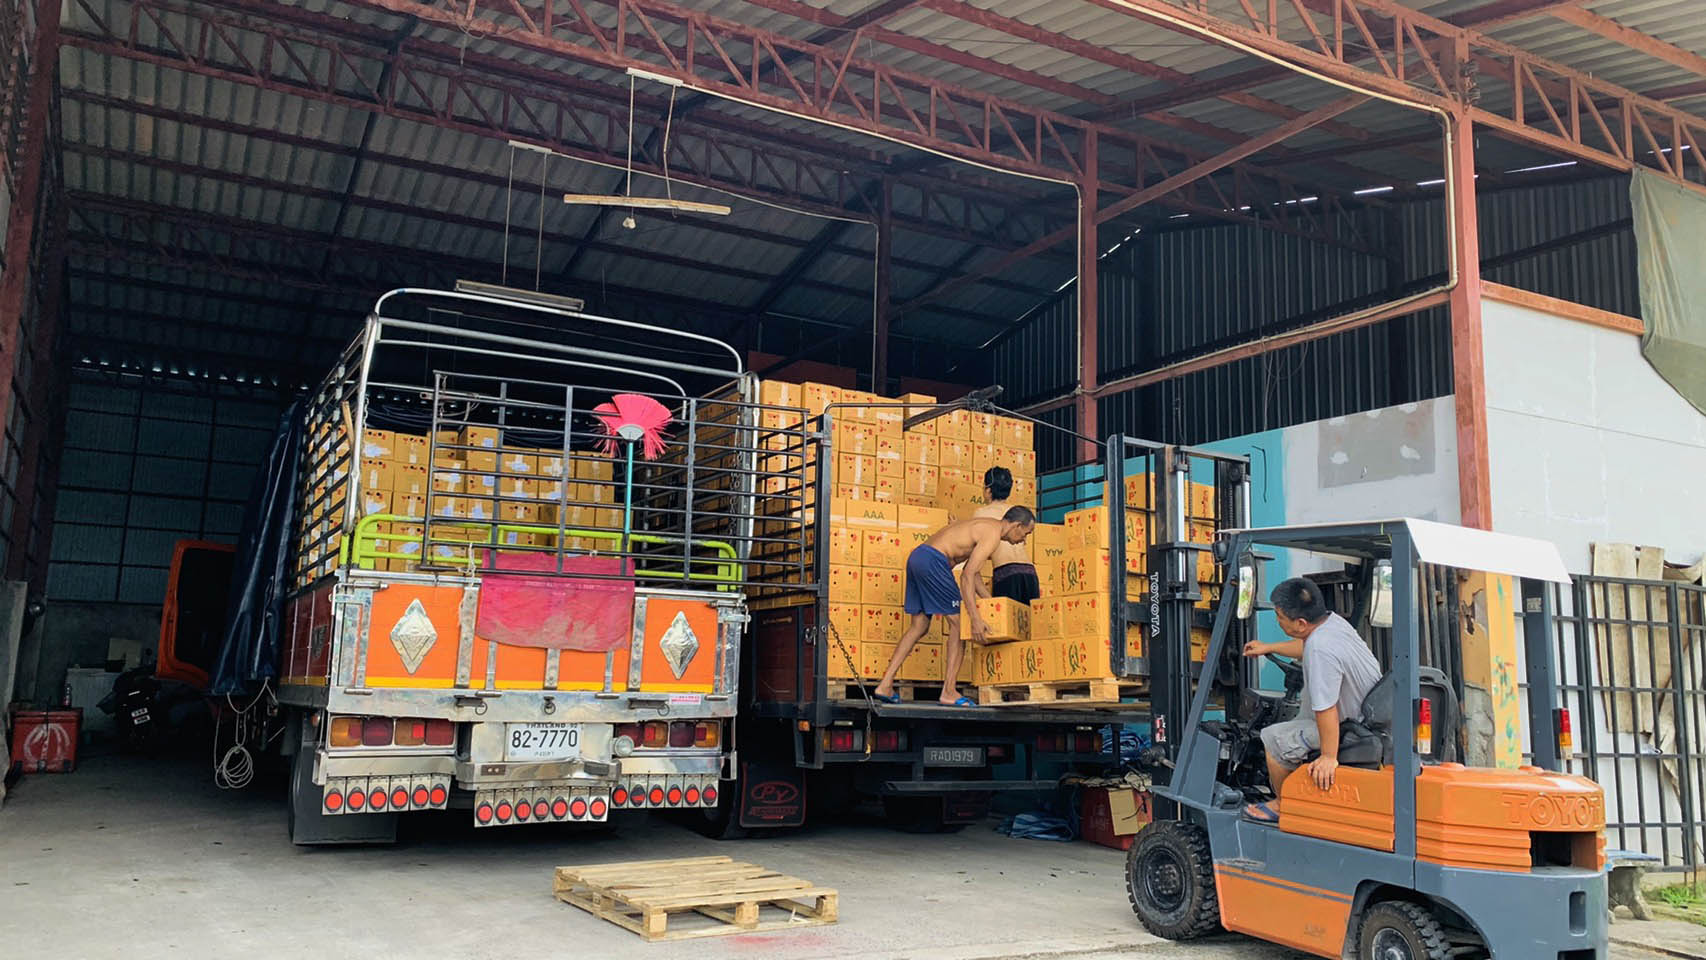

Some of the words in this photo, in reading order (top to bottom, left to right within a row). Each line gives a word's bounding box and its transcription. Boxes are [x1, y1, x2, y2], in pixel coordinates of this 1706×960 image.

[863, 509, 886, 520] AAA
[1150, 571, 1161, 638] TOYOTA
[511, 730, 578, 748] 82-7770
